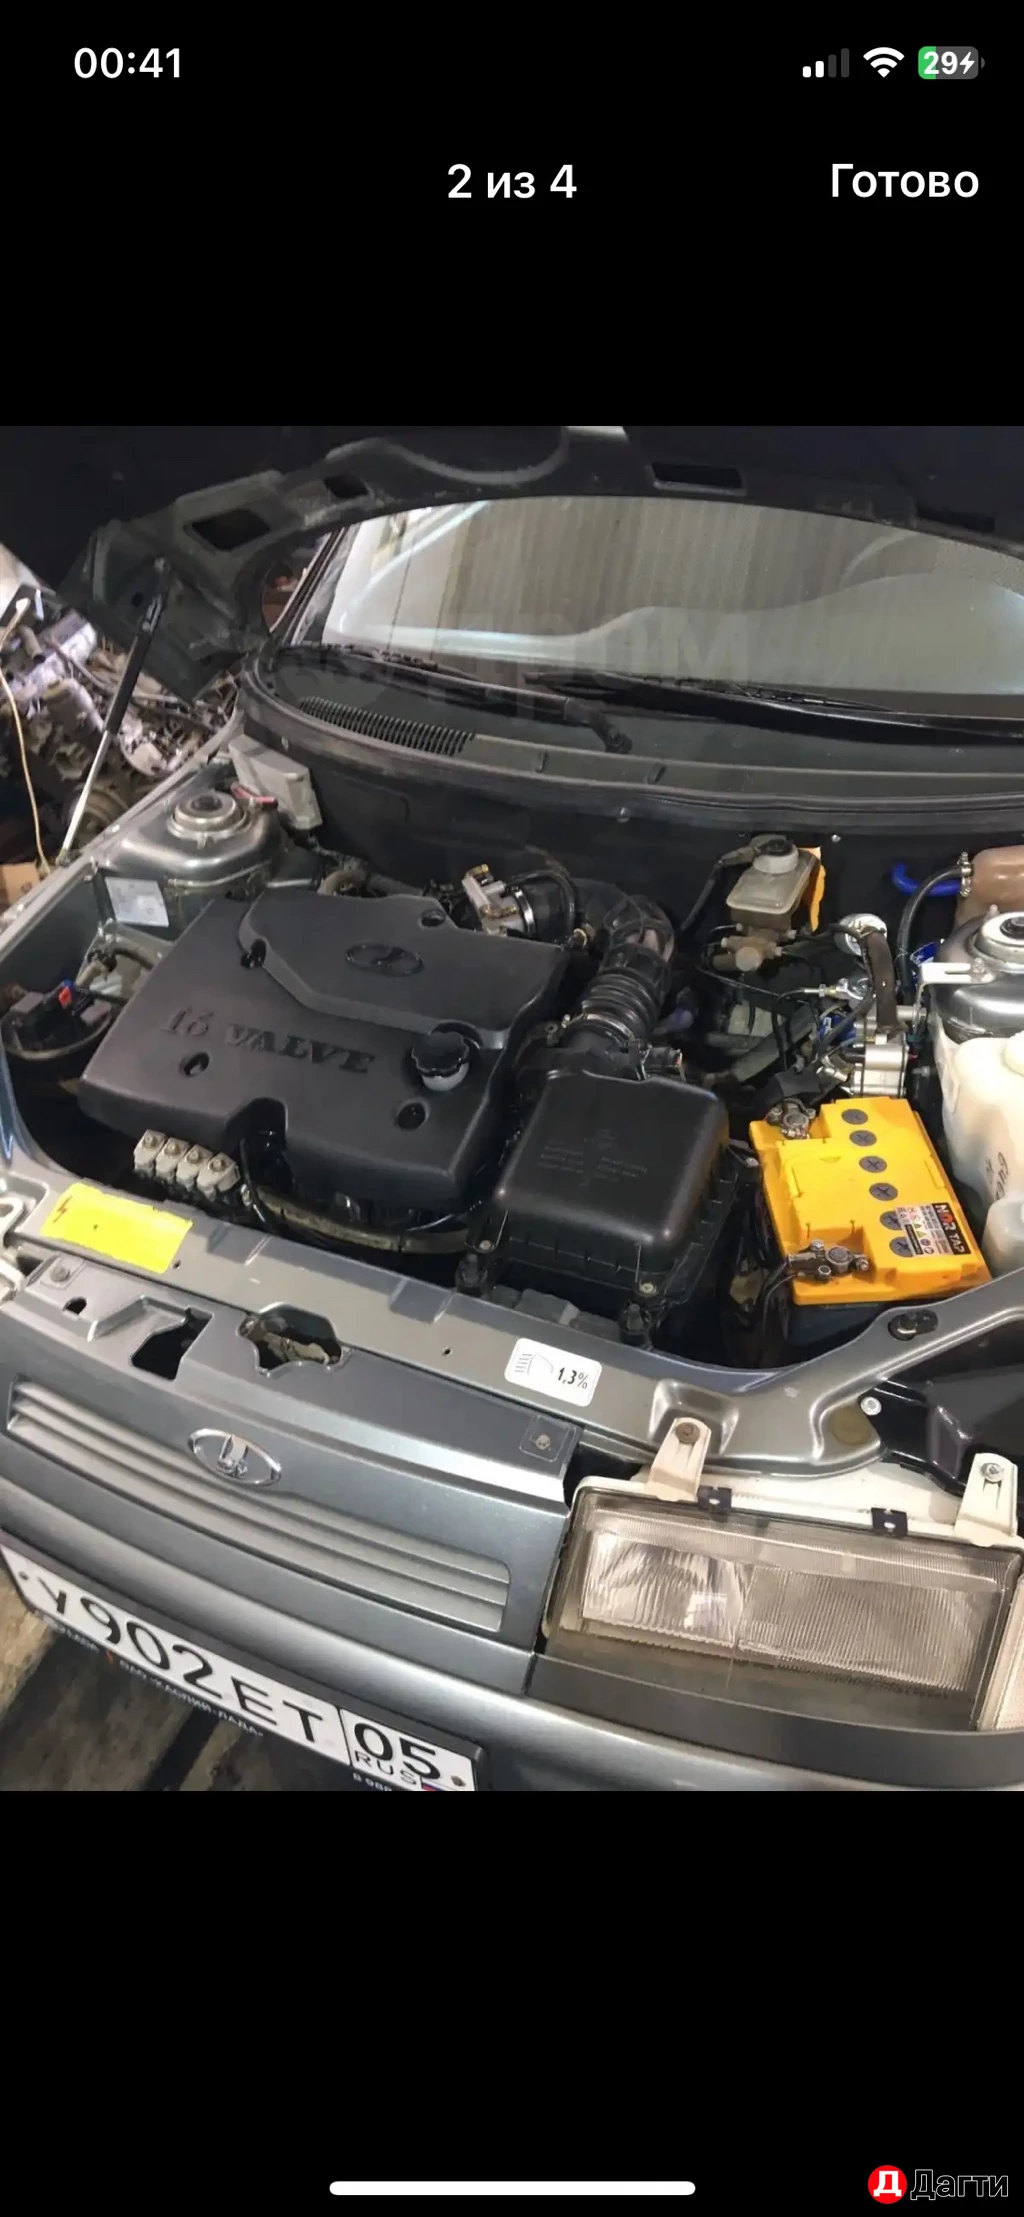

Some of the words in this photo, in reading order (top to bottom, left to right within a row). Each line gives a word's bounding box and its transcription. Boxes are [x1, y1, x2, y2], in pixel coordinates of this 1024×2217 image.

[161, 1006, 214, 1037] 16
[225, 1023, 377, 1074] VALVE
[557, 1366, 589, 1389] 1,3%
[354, 1723, 441, 1780] 05
[354, 1750, 418, 1785] RUS
